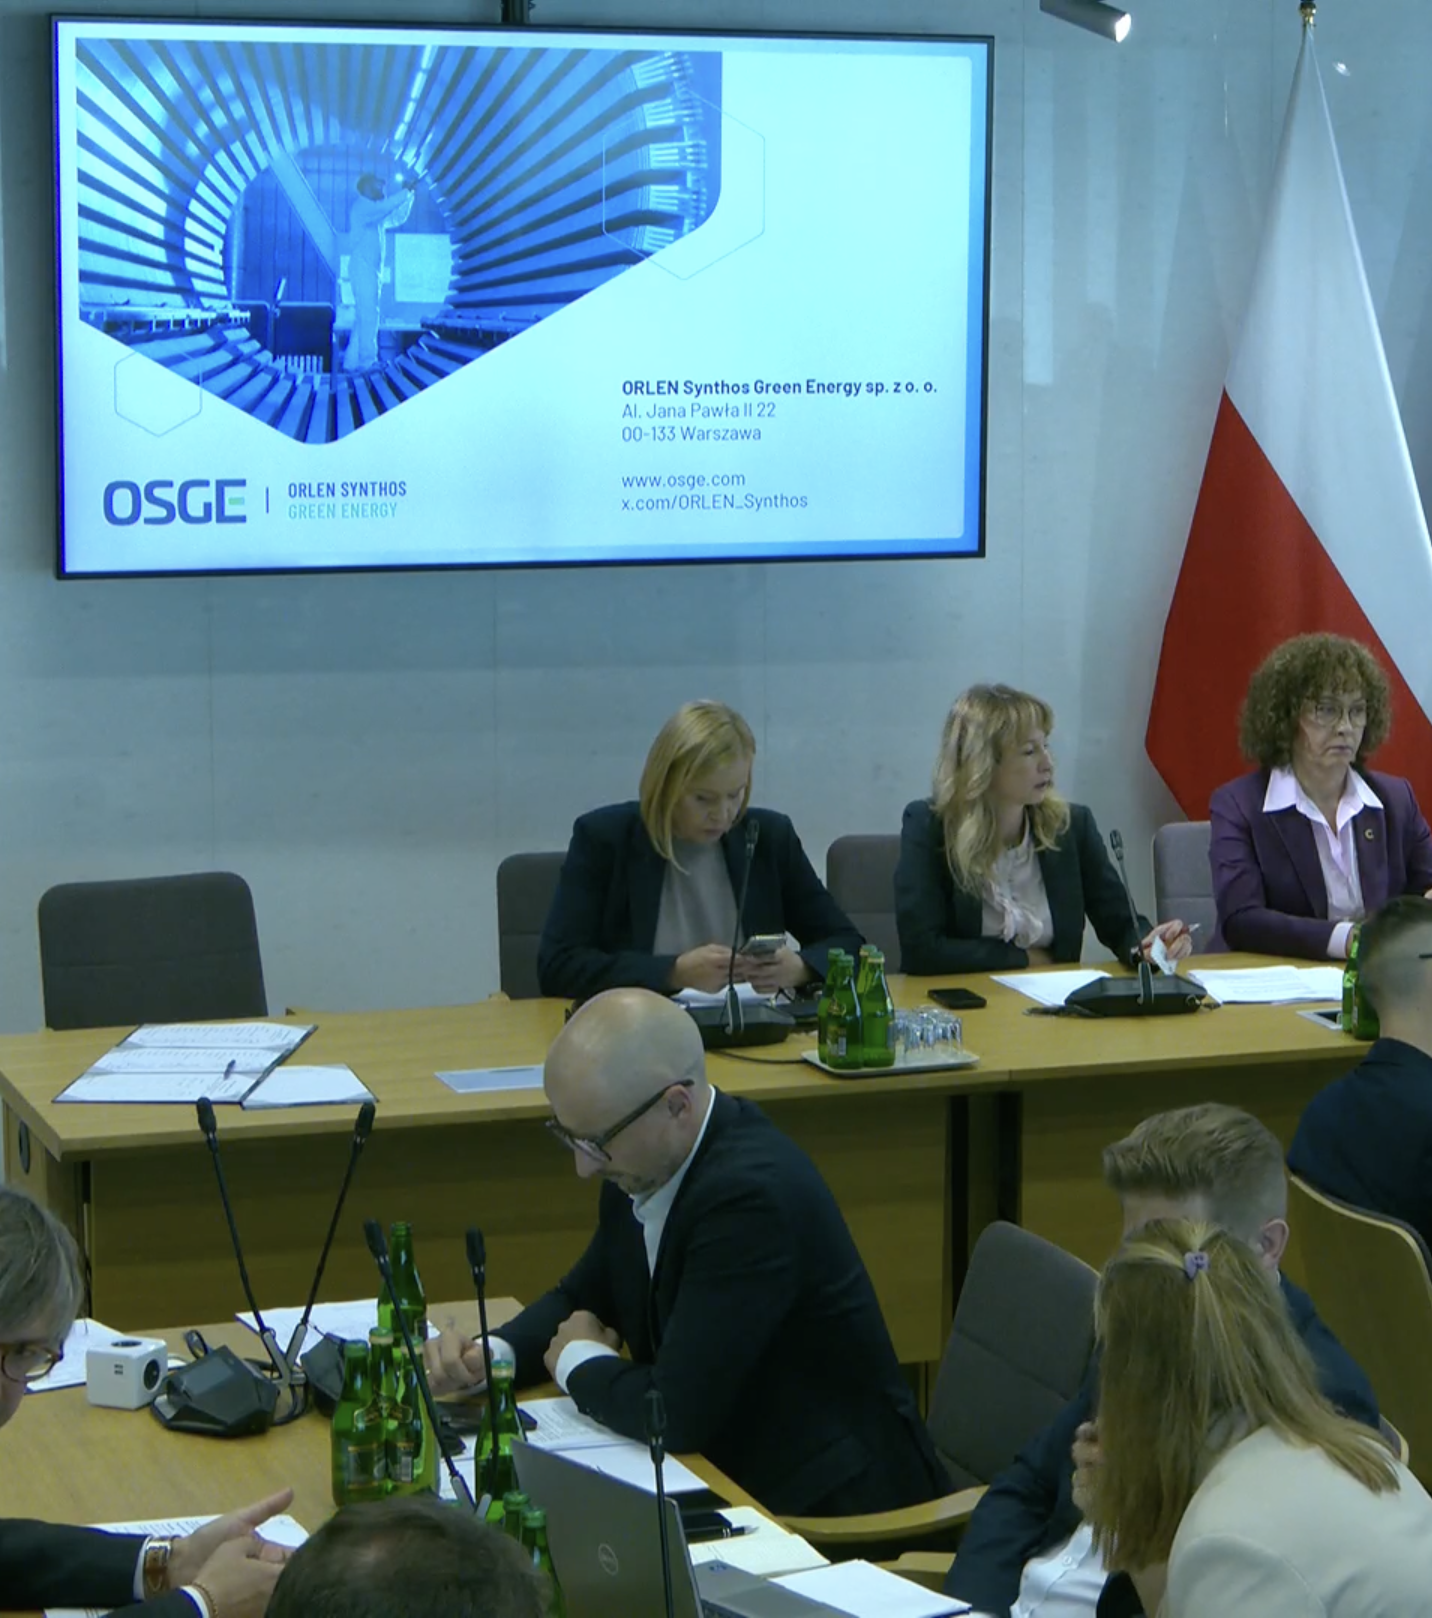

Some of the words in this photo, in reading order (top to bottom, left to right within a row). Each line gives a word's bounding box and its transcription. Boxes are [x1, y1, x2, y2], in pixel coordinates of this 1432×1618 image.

[621, 380, 679, 396] ORLEN
[683, 379, 750, 398] Synthos
[754, 379, 801, 395] Green
[806, 379, 862, 398] Energy
[865, 381, 889, 397] sp.
[893, 382, 901, 393] z
[905, 381, 919, 393] o.
[923, 381, 937, 393] o.
[622, 403, 642, 418] Al.
[646, 403, 686, 418] Jana
[691, 402, 740, 418] Pawła
[744, 402, 752, 416] II
[757, 401, 776, 417] 22
[621, 426, 676, 442] 00-133
[680, 425, 761, 441] Warszawa
[288, 482, 335, 498] ORLEN
[341, 481, 407, 497] SYNTHOS
[621, 473, 746, 490] www.osge.com
[102, 478, 247, 526] OSGE
[288, 504, 336, 519] GREEN
[341, 502, 398, 518] ENERGY
[621, 493, 808, 512] x.com/ORLEN_Synthos
